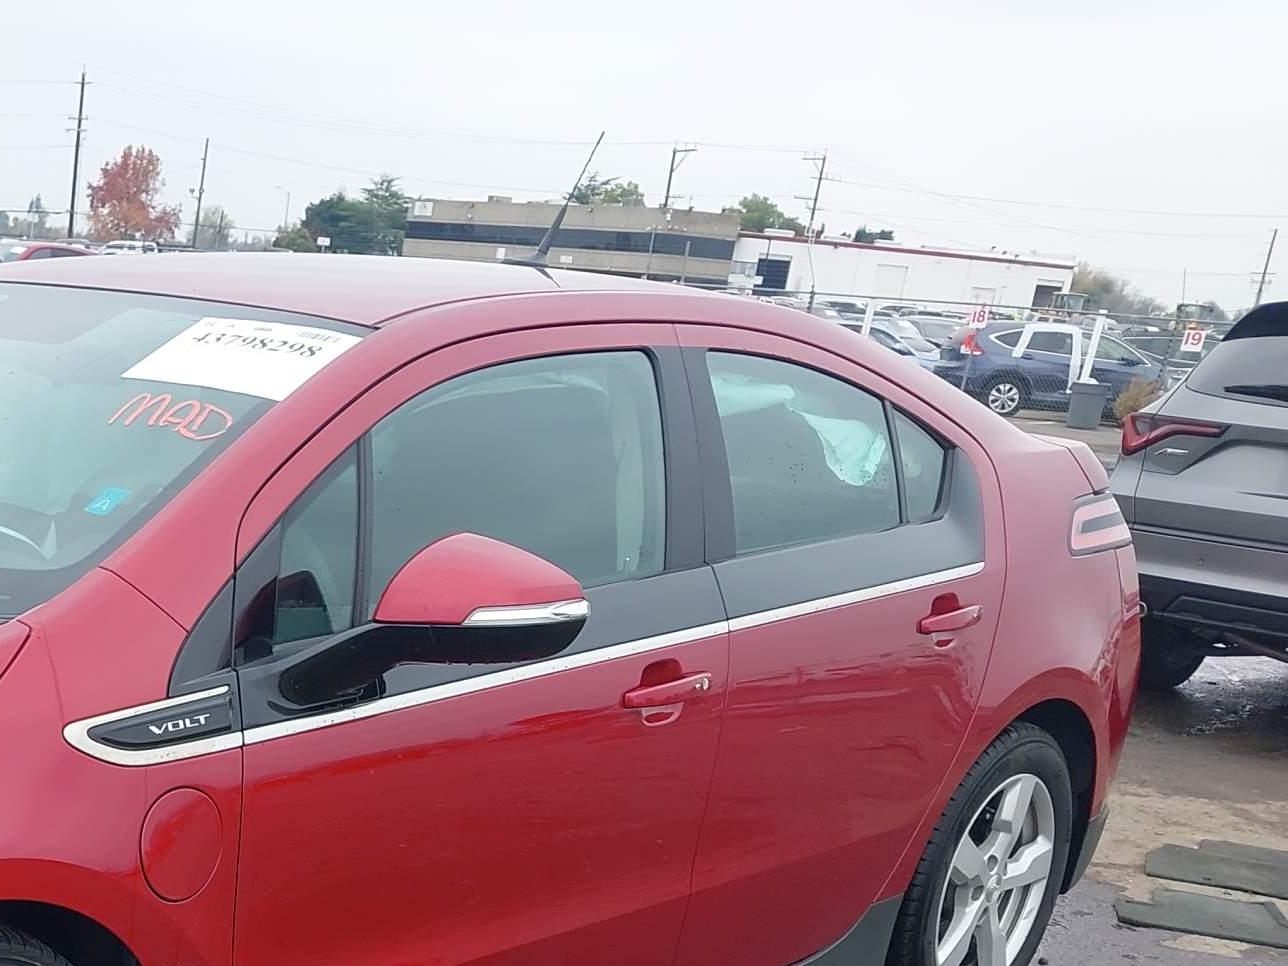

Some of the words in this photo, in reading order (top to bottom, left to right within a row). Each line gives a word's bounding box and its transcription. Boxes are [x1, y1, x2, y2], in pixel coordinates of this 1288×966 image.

[971, 309, 987, 323] 18
[192, 331, 323, 358] 43798298
[1183, 331, 1203, 346] 19
[148, 713, 211, 735] VOLT
